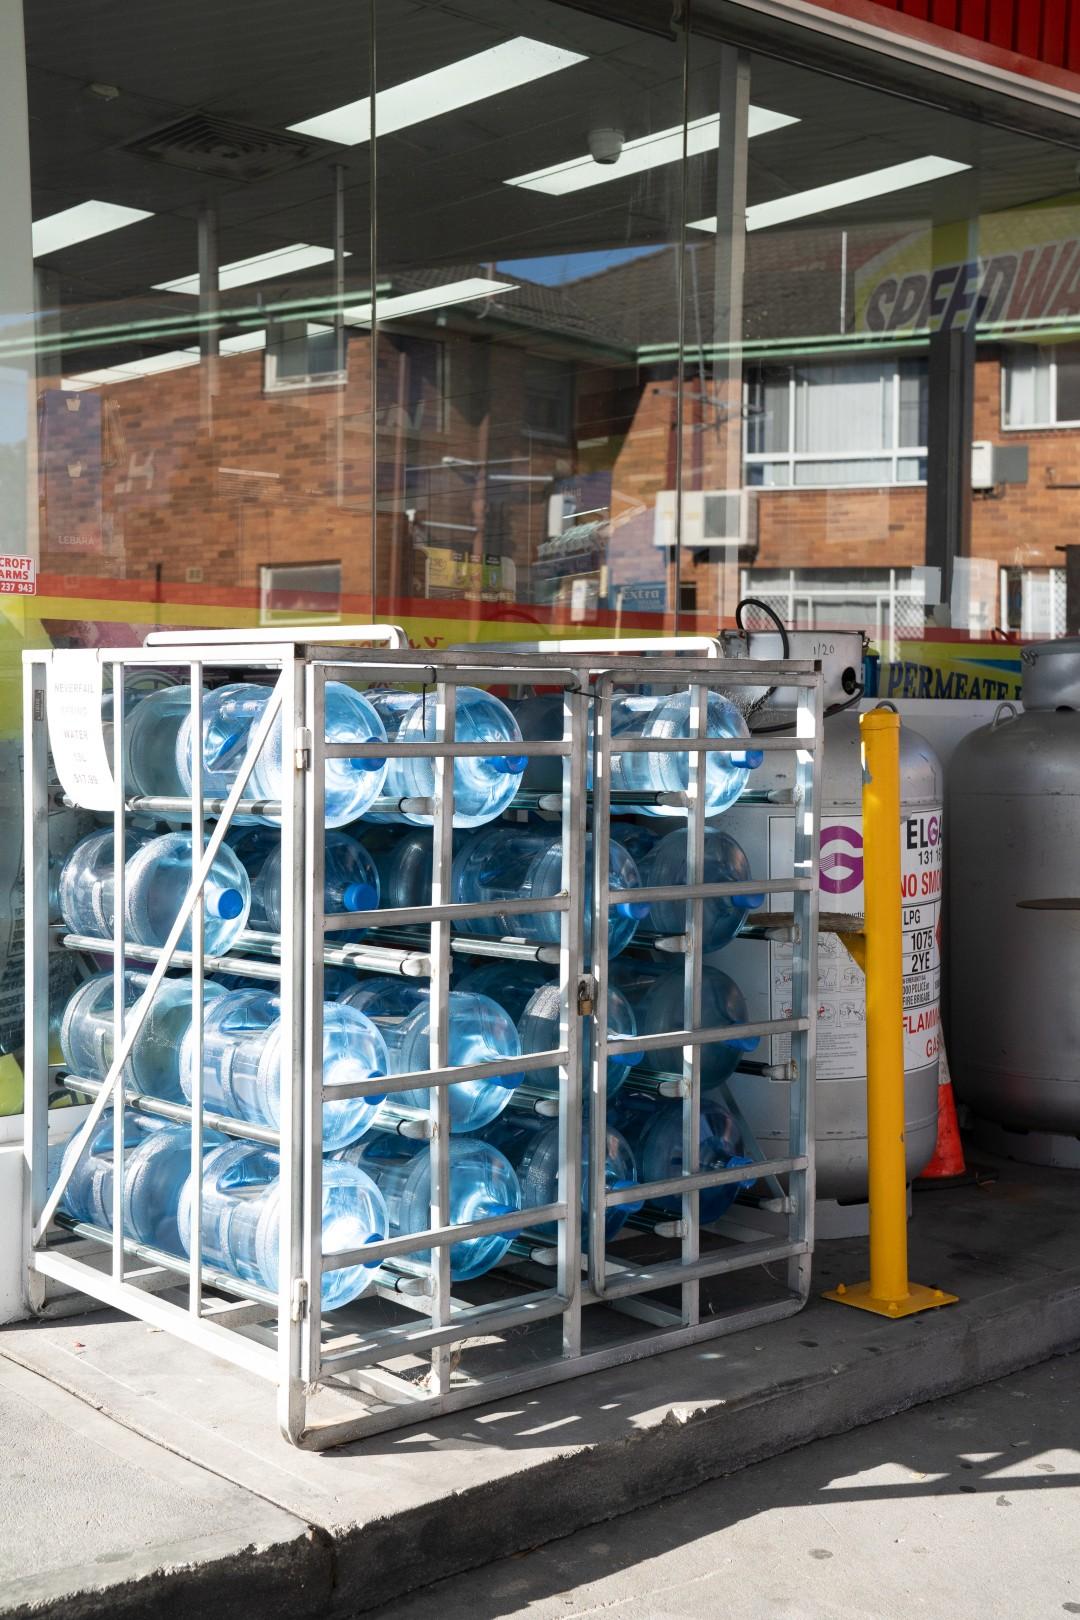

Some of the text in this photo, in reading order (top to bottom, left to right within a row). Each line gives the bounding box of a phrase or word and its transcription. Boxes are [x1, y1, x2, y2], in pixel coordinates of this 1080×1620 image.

[1, 582, 33, 593] 237 943
[886, 661, 1009, 700] PERMEATE
[64, 729, 88, 740] WATER
[918, 850, 933, 865] 131
[901, 873, 918, 897] NO
[903, 909, 921, 925] LPG
[911, 930, 933, 951] 1075
[911, 952, 930, 973] 2YE
